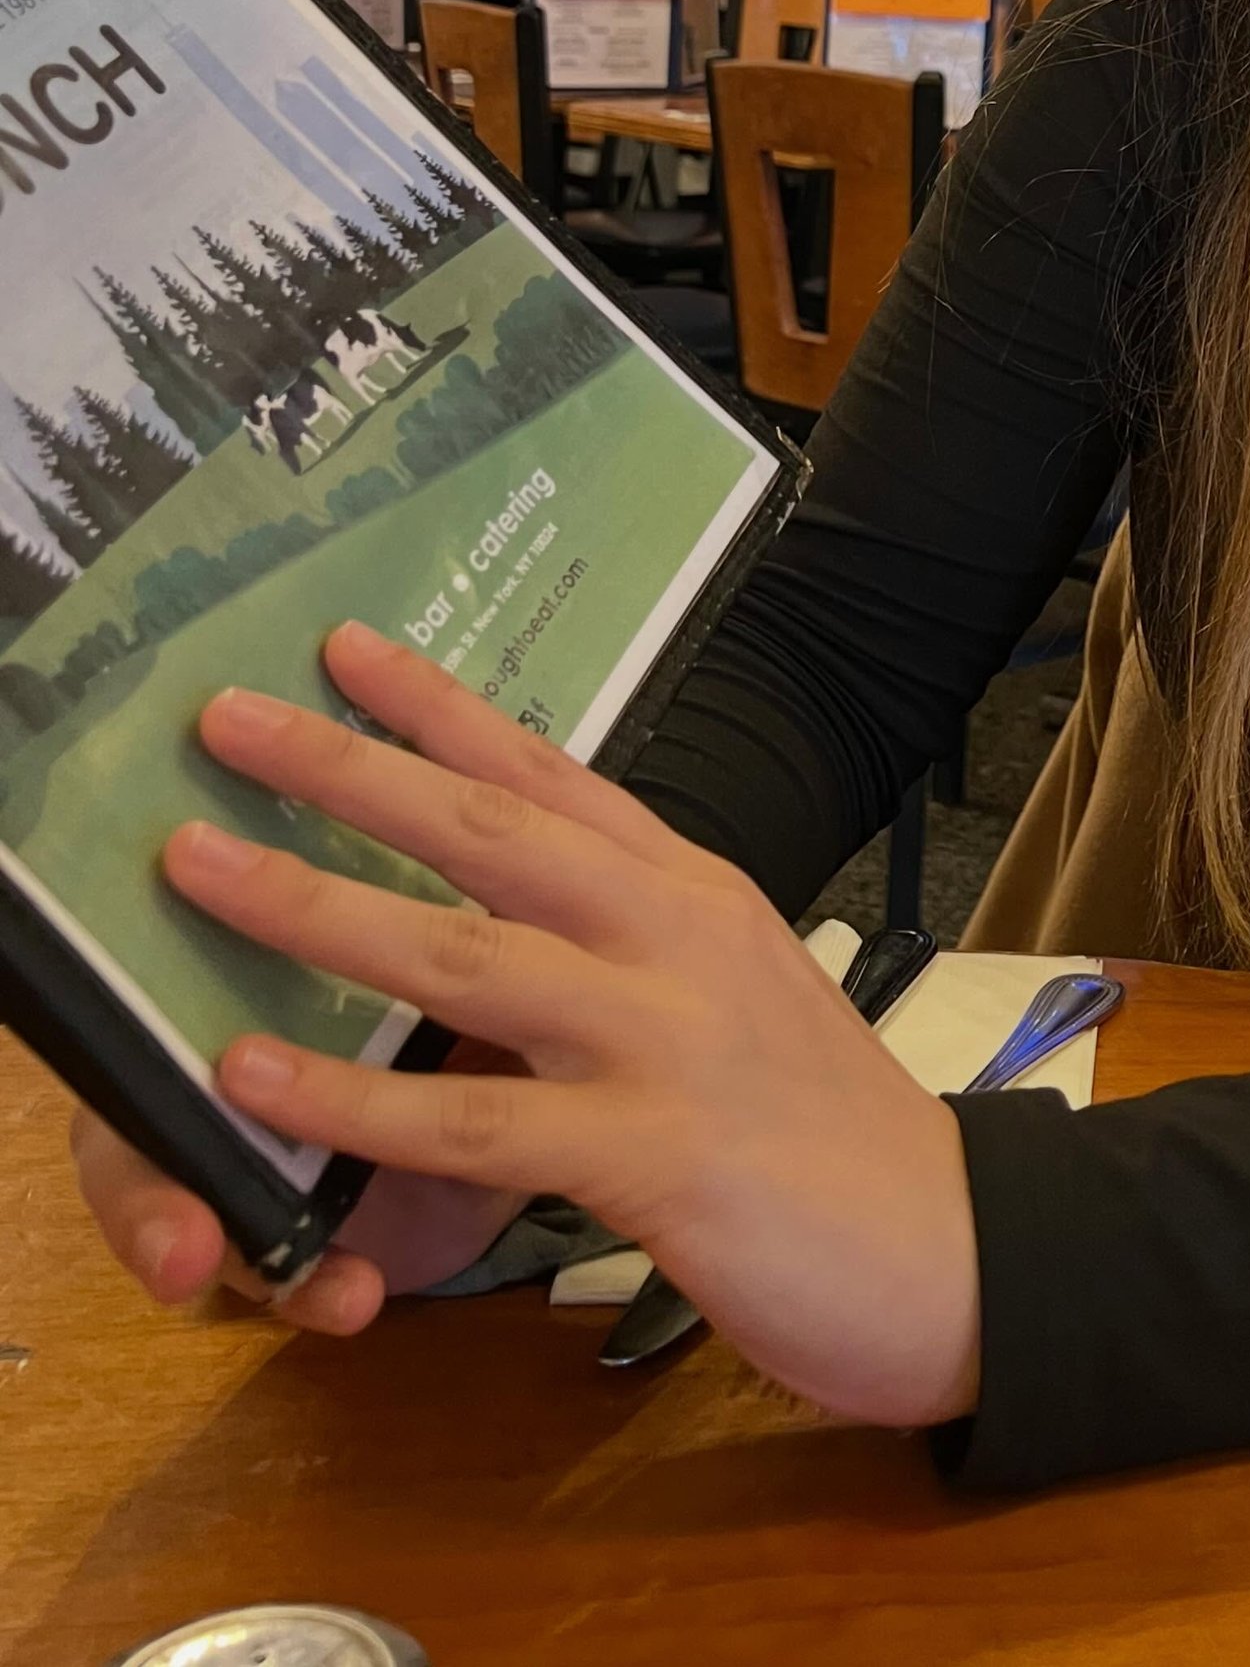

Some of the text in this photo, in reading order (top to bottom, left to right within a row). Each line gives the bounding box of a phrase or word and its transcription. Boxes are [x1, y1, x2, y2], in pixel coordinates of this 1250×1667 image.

[0, 24, 166, 196] NCH
[404, 467, 557, 648] bar catering
[472, 603, 499, 633] New
[515, 552, 535, 576] NY
